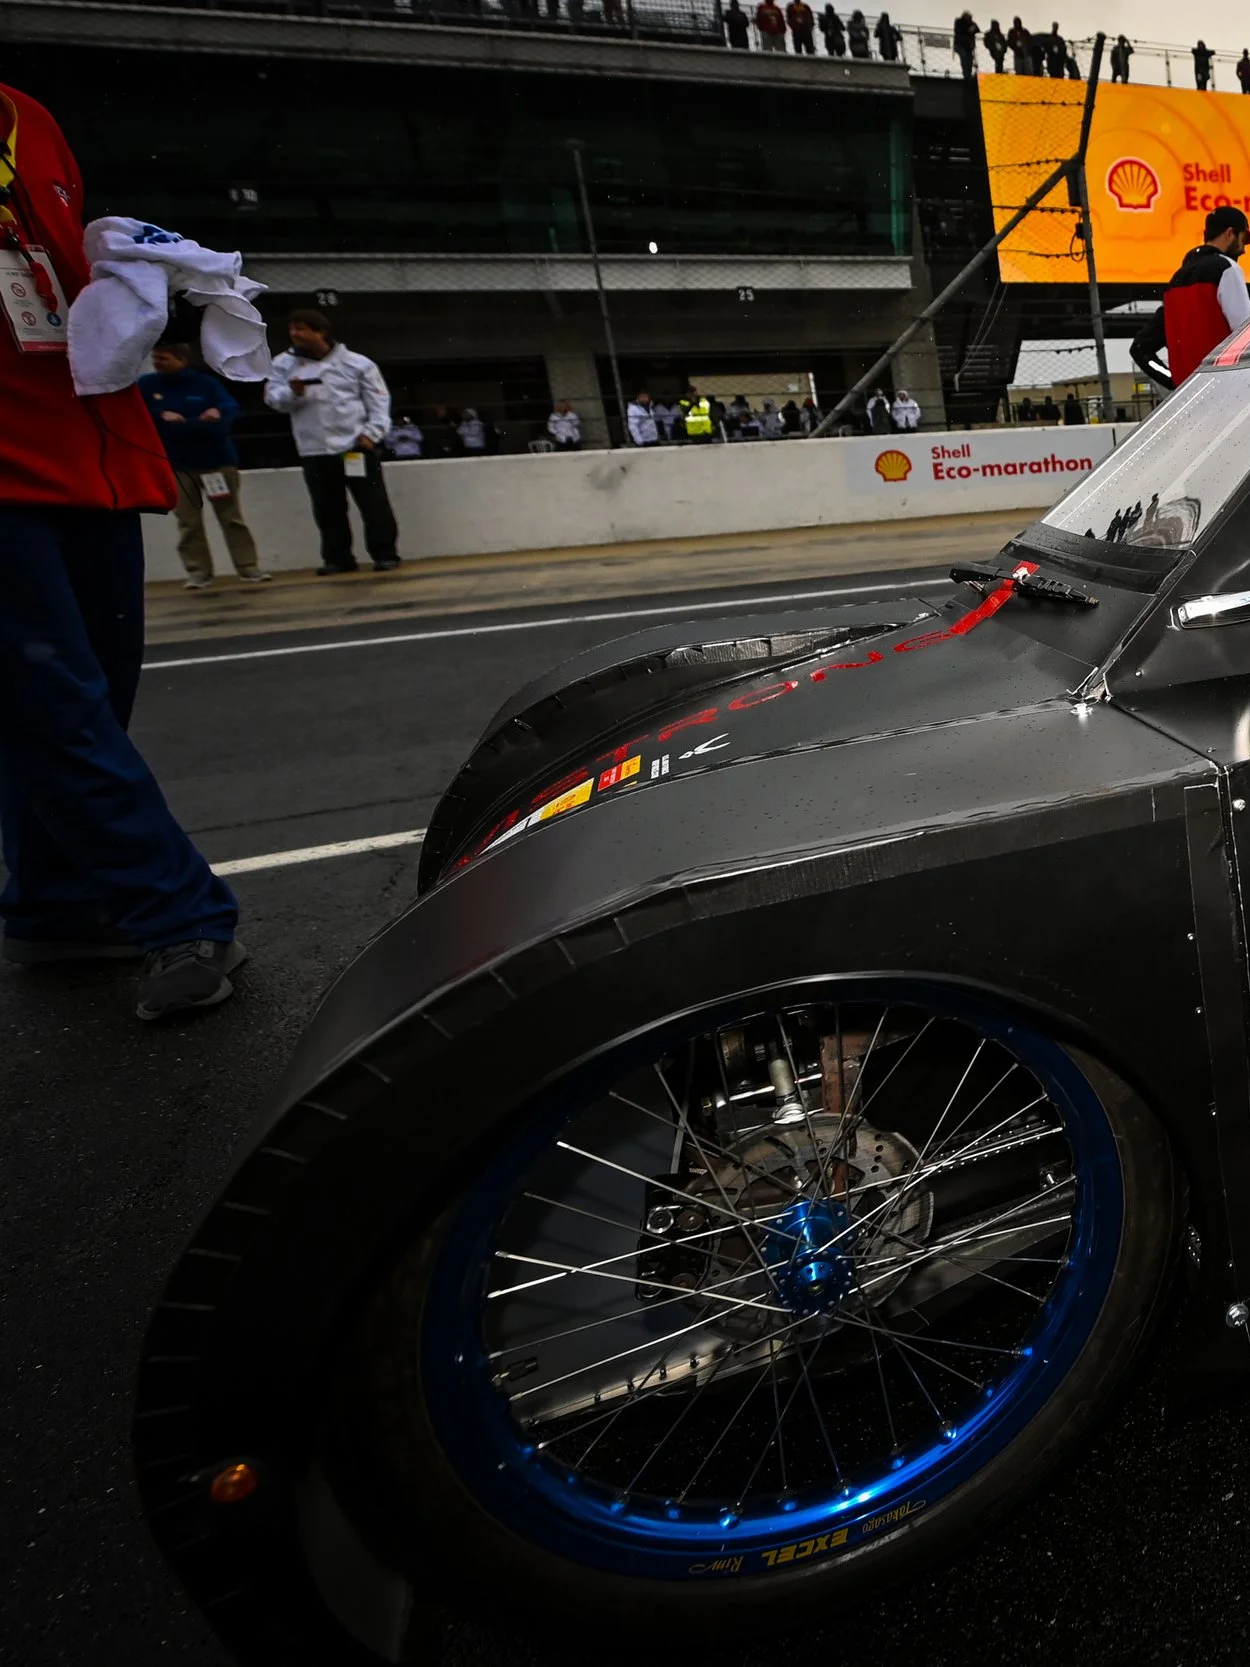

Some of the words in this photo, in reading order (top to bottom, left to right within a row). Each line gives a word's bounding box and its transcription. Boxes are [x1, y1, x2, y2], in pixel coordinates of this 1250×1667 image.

[1183, 162, 1232, 184] Shell
[931, 443, 971, 460] Shell
[932, 453, 1093, 481] Eco-marathon
[862, 1500, 925, 1534] Takasago
[761, 1528, 849, 1567] EXCEL
